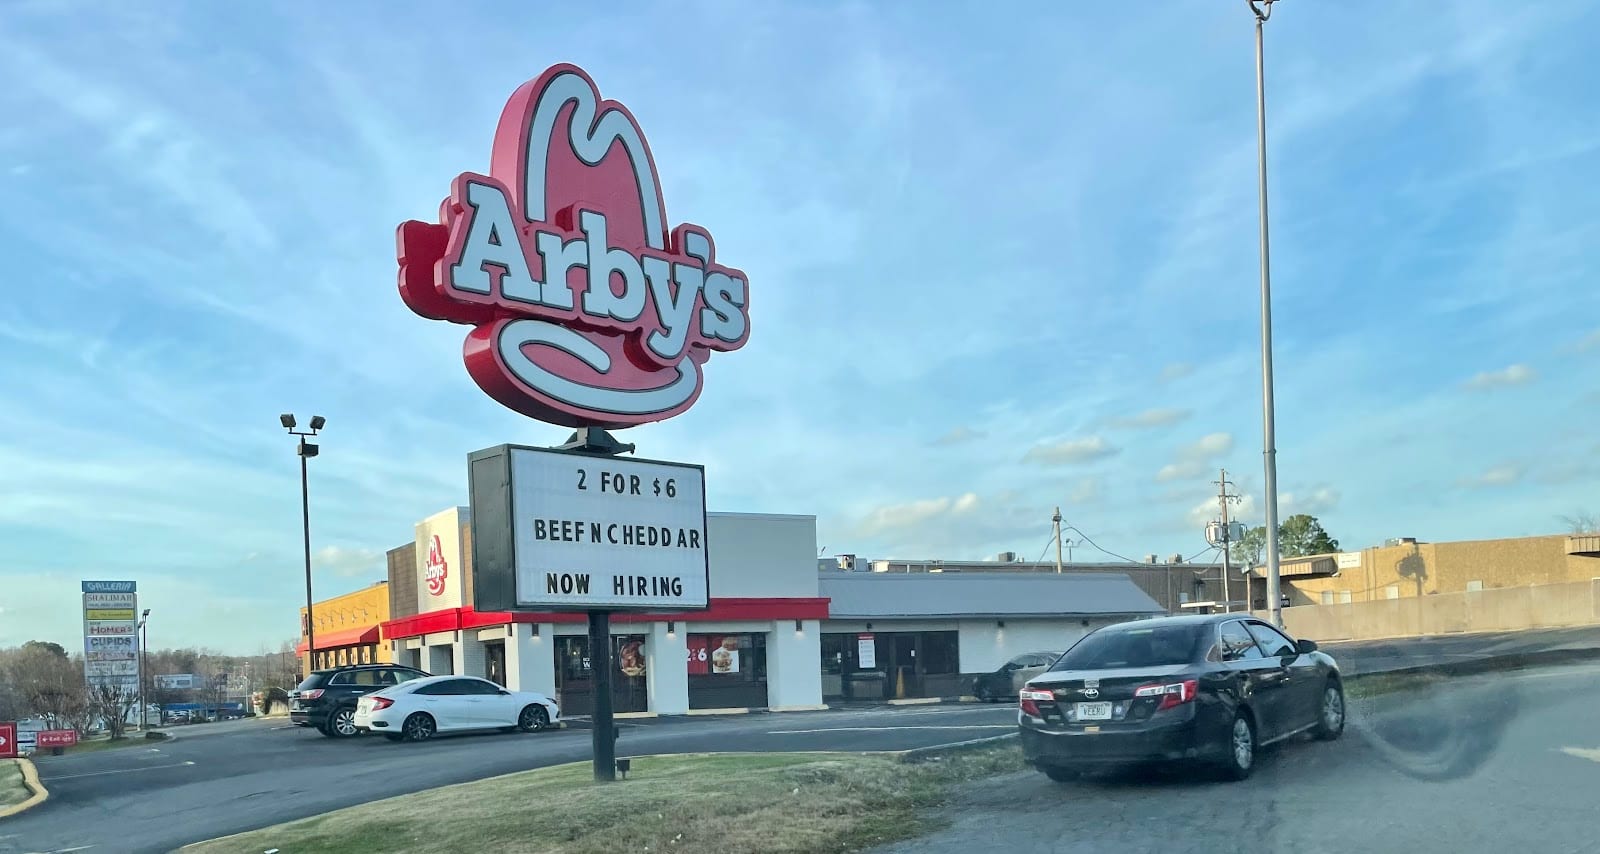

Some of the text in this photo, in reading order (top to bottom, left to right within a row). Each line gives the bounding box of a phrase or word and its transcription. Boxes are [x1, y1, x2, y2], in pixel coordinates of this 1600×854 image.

[451, 179, 748, 360] Arby's
[577, 469, 676, 498] 2 FOR $6
[87, 582, 132, 591] GALLERIA
[547, 573, 682, 597] NOW HIRING
